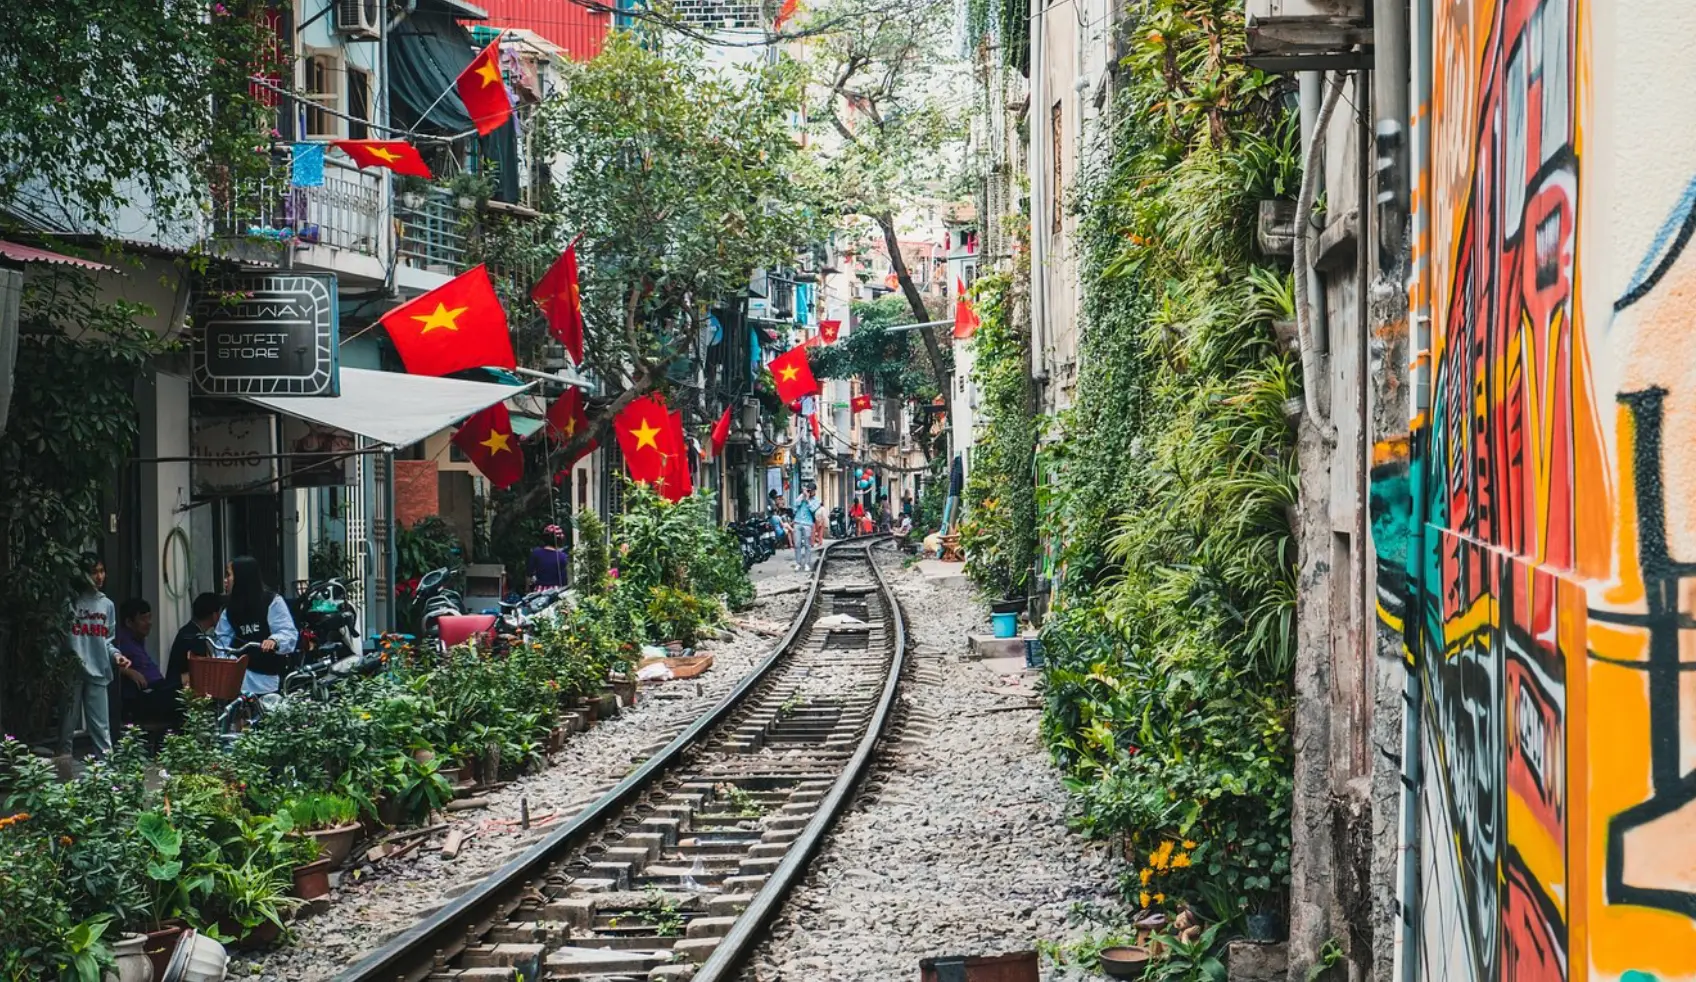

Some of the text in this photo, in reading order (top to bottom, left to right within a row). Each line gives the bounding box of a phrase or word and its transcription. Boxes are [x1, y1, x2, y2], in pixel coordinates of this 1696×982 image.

[195, 304, 314, 318] RAILWAY
[217, 333, 289, 345] OUTFIT
[217, 347, 280, 359] STORE
